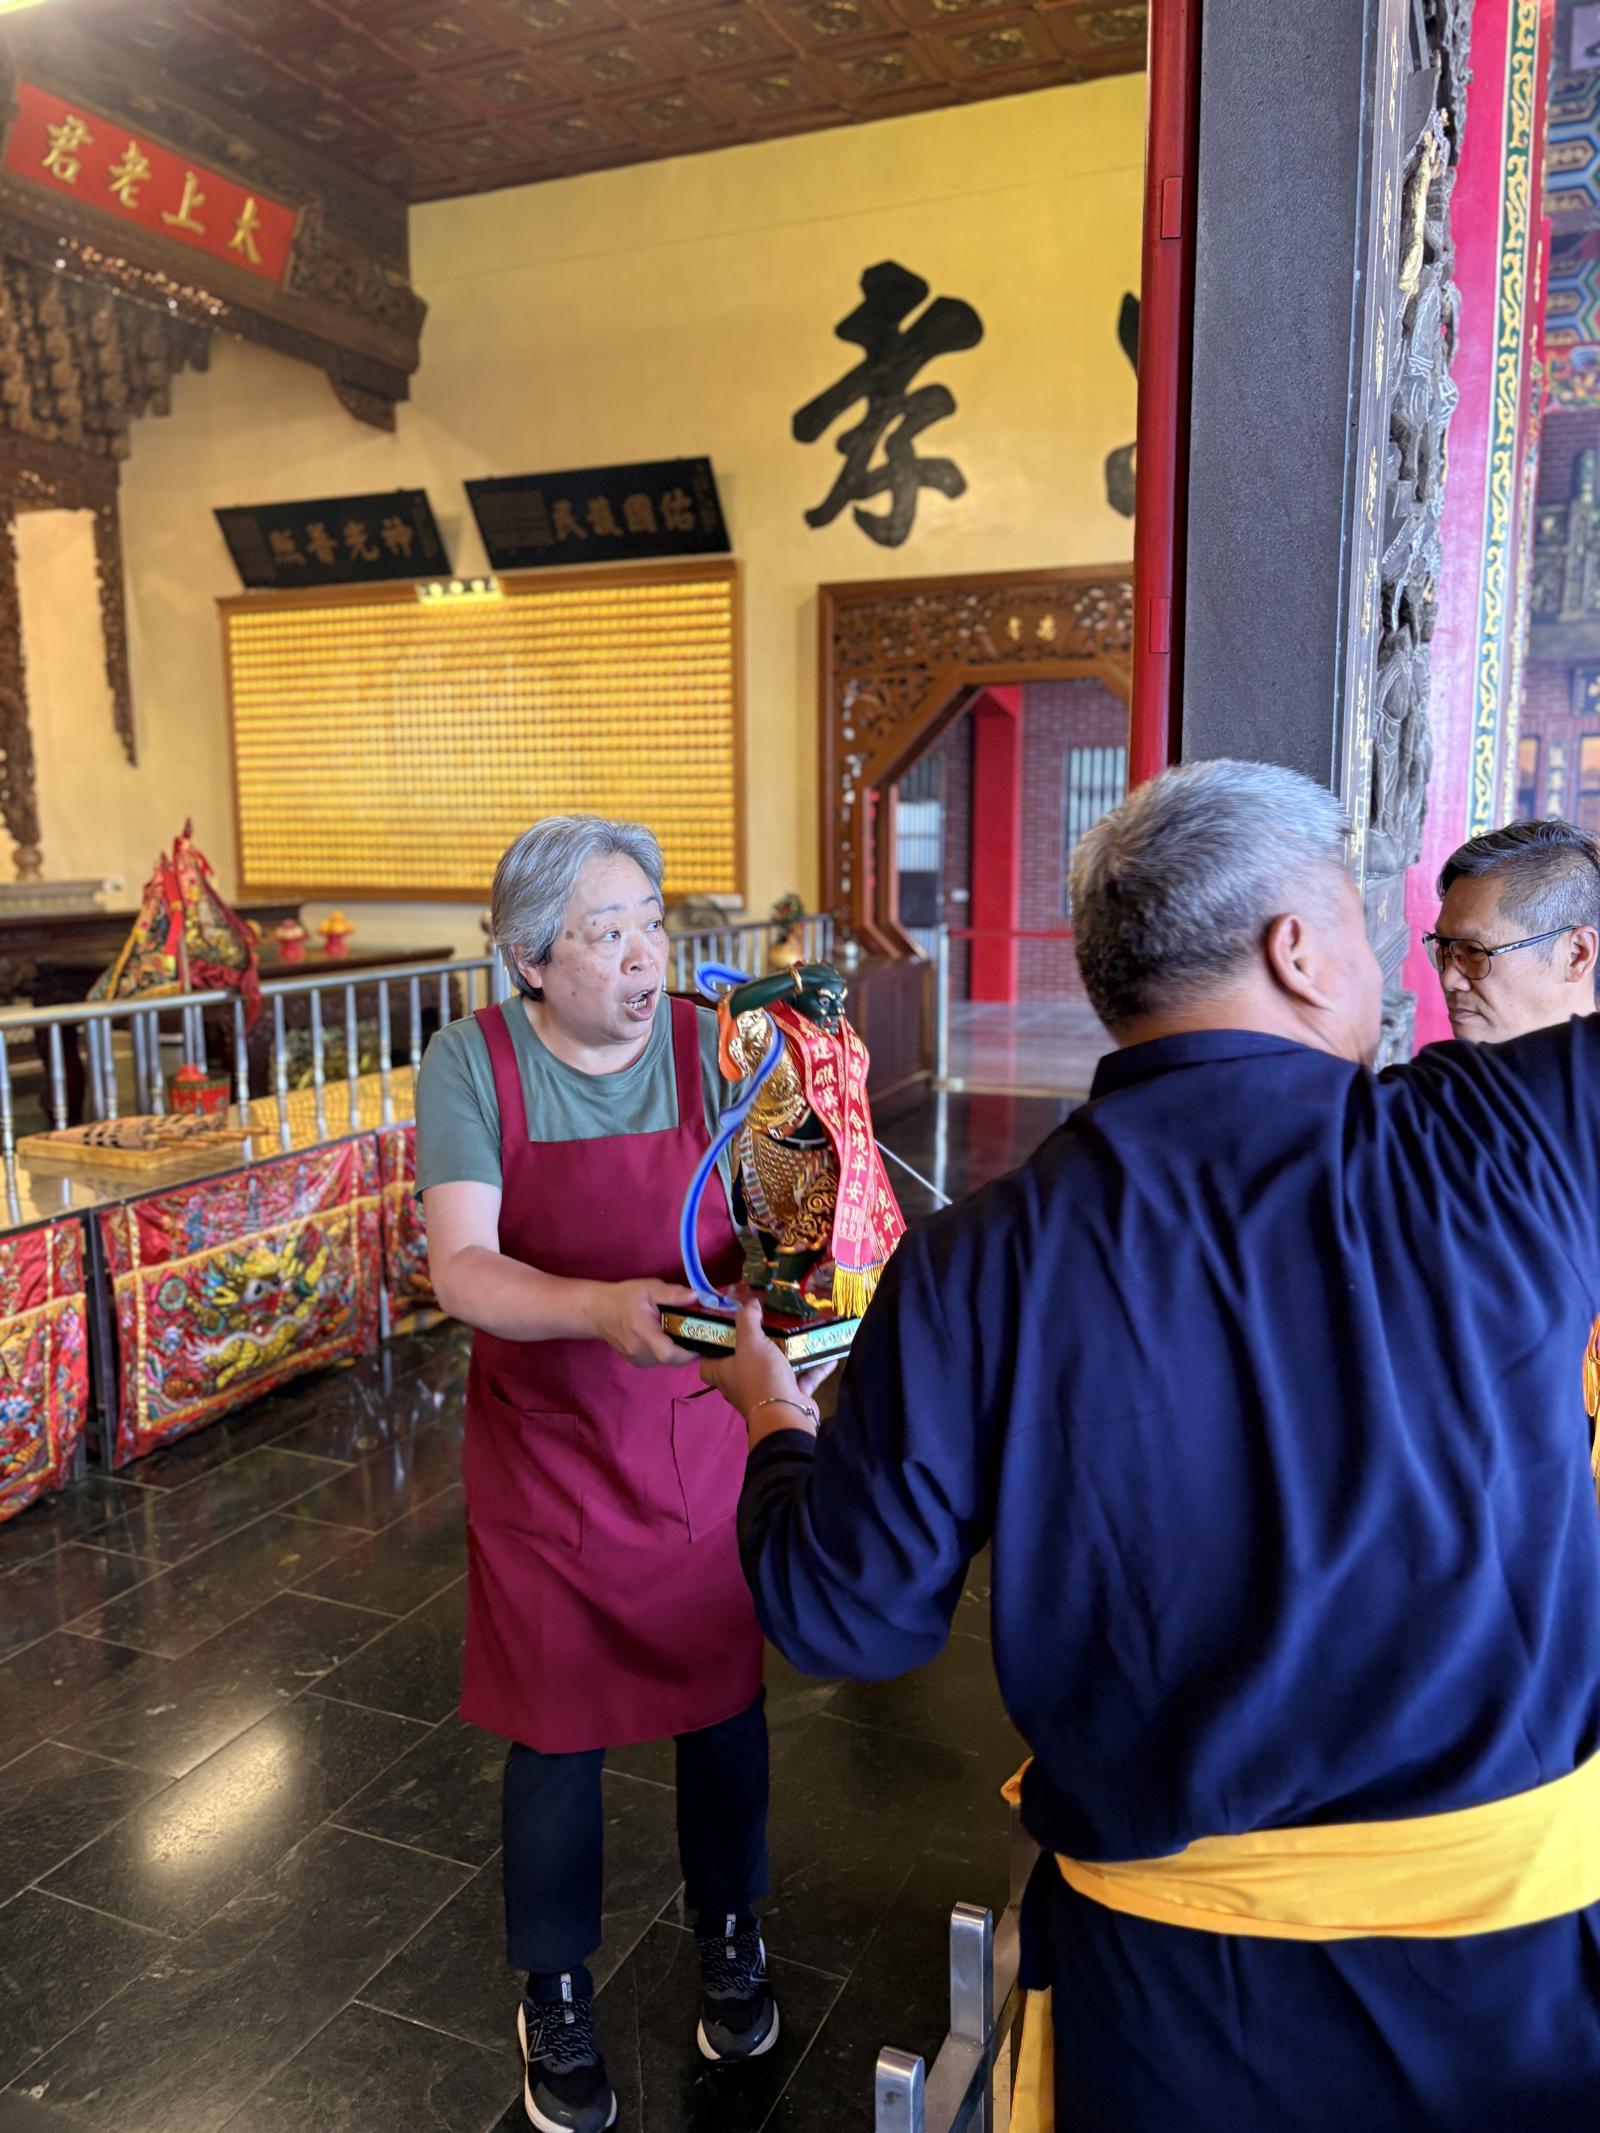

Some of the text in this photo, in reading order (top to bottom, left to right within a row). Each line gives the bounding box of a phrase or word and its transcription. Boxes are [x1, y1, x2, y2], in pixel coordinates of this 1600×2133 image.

[42, 114, 263, 264] 太上老君
[792, 260, 984, 548] 孝
[268, 514, 413, 566] 神光普照
